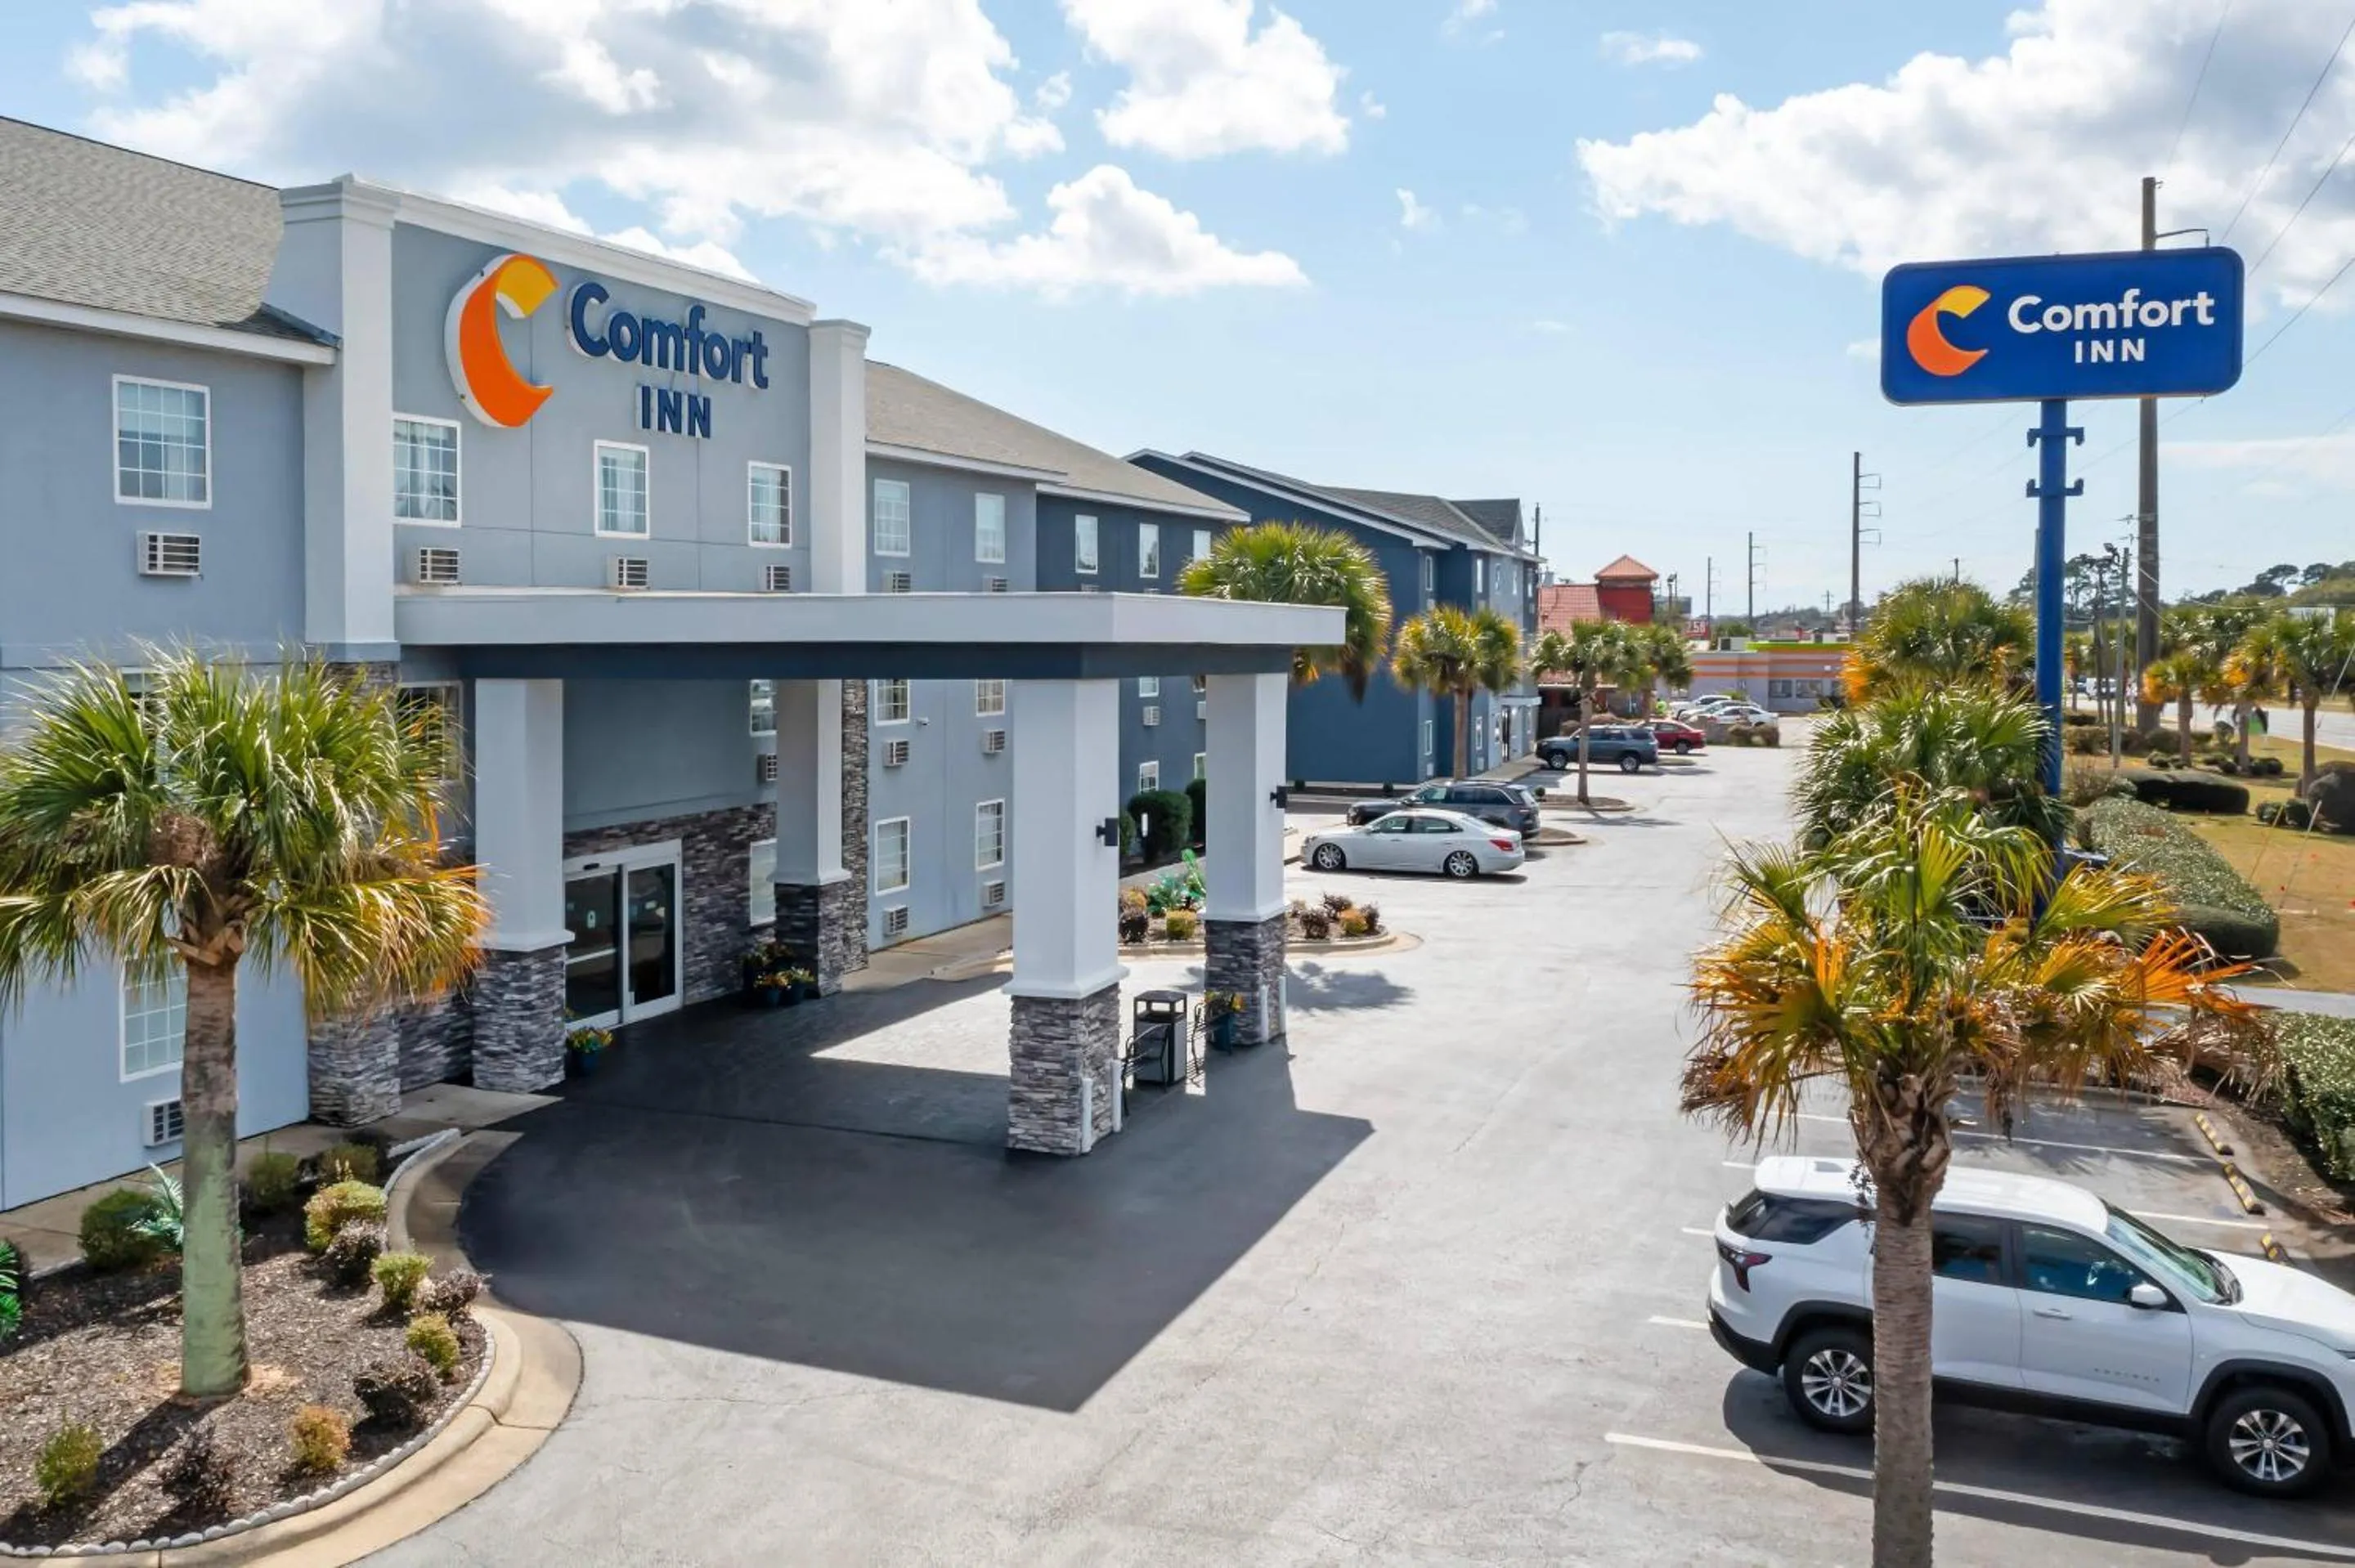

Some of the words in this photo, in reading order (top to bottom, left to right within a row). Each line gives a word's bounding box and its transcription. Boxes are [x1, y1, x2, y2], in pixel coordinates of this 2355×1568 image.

[569, 280, 769, 390] Comfort
[2007, 288, 2215, 334] Comfort
[2075, 338, 2145, 363] INN
[639, 384, 711, 439] INN
